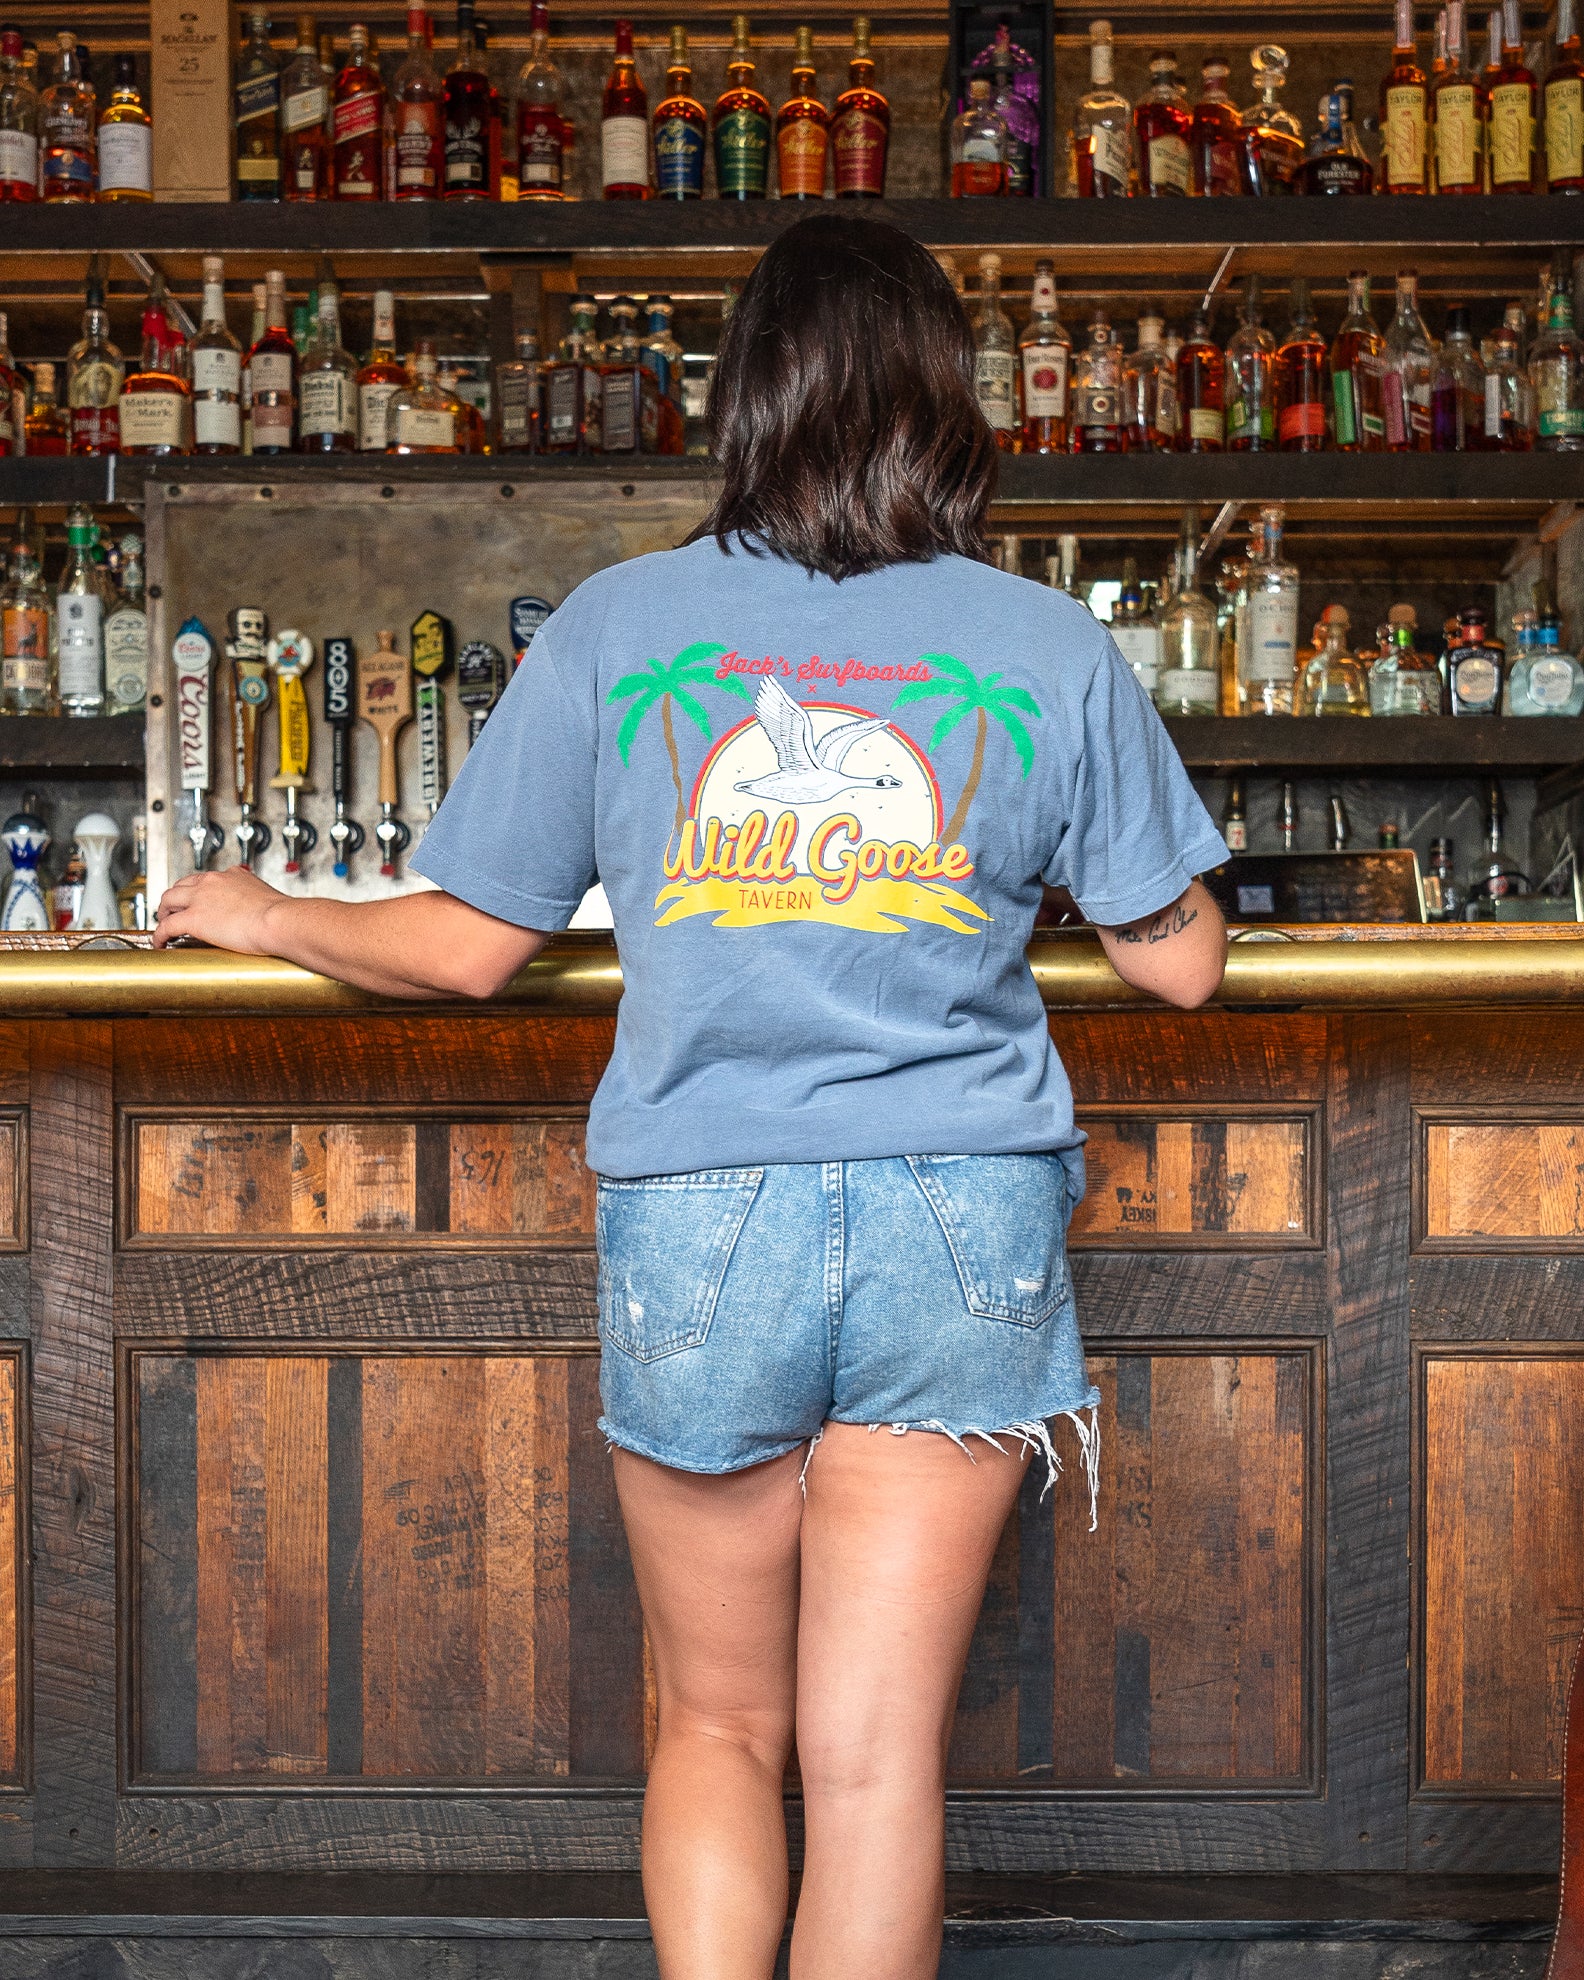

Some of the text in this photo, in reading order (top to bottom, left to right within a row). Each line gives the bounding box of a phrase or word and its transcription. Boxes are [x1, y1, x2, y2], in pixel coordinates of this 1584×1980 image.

[179, 57, 200, 72] 25
[329, 641, 349, 713] 805
[715, 650, 933, 687] Jack's Surfboards
[180, 673, 209, 769] Coors
[663, 810, 975, 905] Wild Goose
[738, 889, 813, 911] TAVERN
